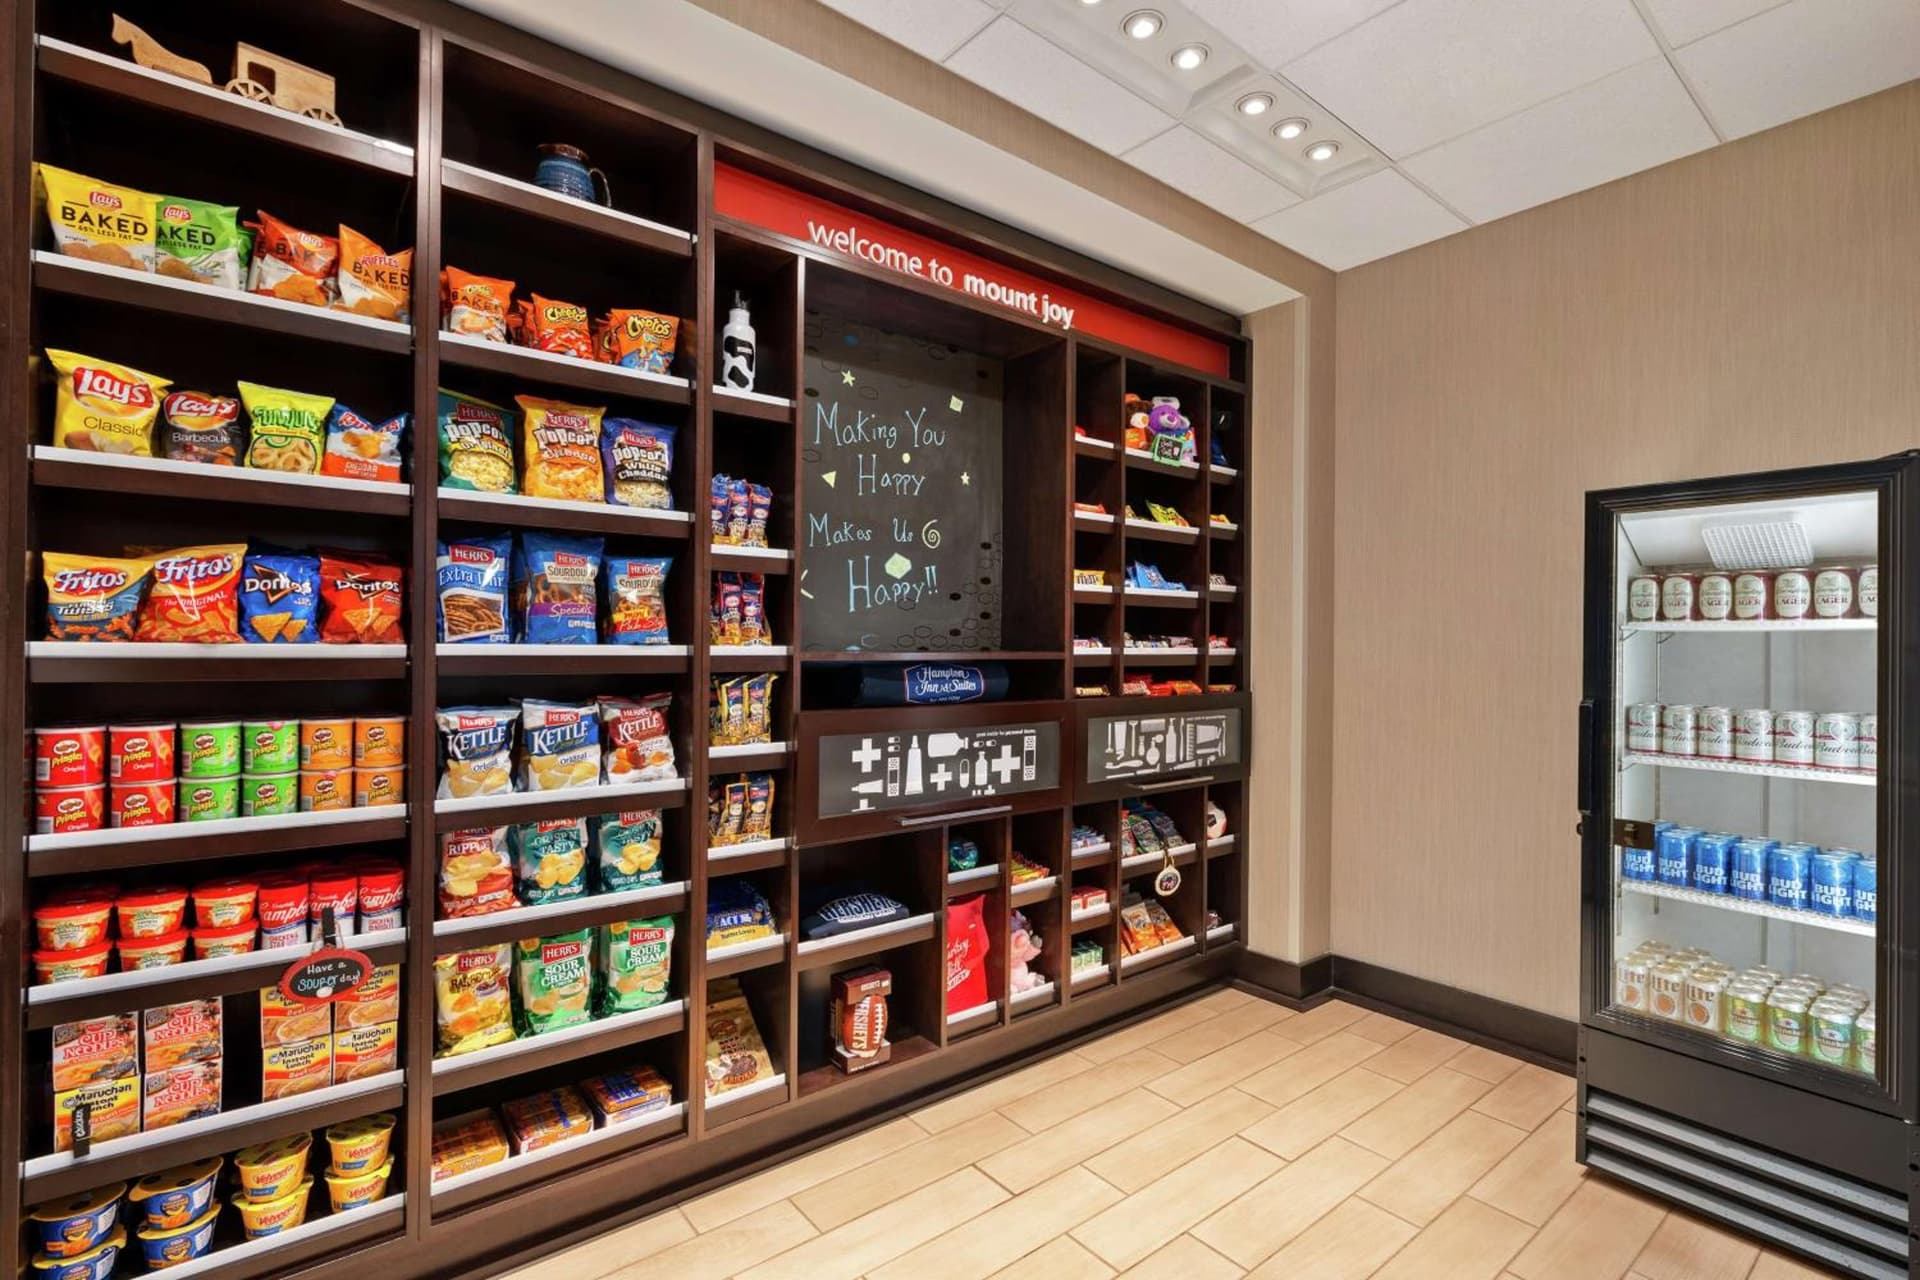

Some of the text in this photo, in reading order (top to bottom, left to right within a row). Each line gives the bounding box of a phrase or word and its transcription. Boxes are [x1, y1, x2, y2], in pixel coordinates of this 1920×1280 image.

[61, 205, 149, 237] BAKED
[97, 229, 117, 239] LESS
[118, 232, 133, 242] FAT
[156, 223, 216, 246] AKED
[807, 221, 1075, 330] welcome to mount joy
[83, 415, 144, 438] Classic
[814, 401, 946, 449] Making You
[172, 431, 232, 444] Barbecue
[858, 453, 926, 496] Happy
[809, 513, 913, 547] Makes Us
[155, 554, 234, 583] Fritos
[439, 565, 473, 586] Extra
[547, 565, 596, 578] SOURDOUH
[54, 568, 128, 593] Fritos
[244, 572, 313, 596] Doritos
[335, 579, 401, 593] Doritos
[848, 555, 939, 613] Happy!!
[916, 667, 970, 684] Hampton
[916, 681, 941, 695] Inn
[950, 679, 977, 692] Suites
[617, 715, 661, 742] KETTLE
[446, 726, 506, 759] KETTLE
[532, 721, 589, 755] KETTLE
[52, 752, 83, 768] Pringles
[55, 811, 87, 826] Pringles
[542, 840, 576, 855] TASTY
[1693, 871, 1728, 885] LIGHT
[1696, 864, 1724, 877] BUD
[1771, 876, 1802, 890] BUD
[1815, 883, 1847, 897] BUD
[1769, 884, 1807, 900] LIGHT
[630, 944, 662, 959] SOUR
[307, 963, 334, 975] Have
[544, 959, 580, 976] SOUR
[626, 953, 666, 969] CREAM
[541, 966, 586, 988] CREAM
[168, 1013, 203, 1028] CUP
[78, 1029, 118, 1045] CUP
[279, 1041, 327, 1059] Maruchan
[75, 1084, 132, 1102] Maruchan
